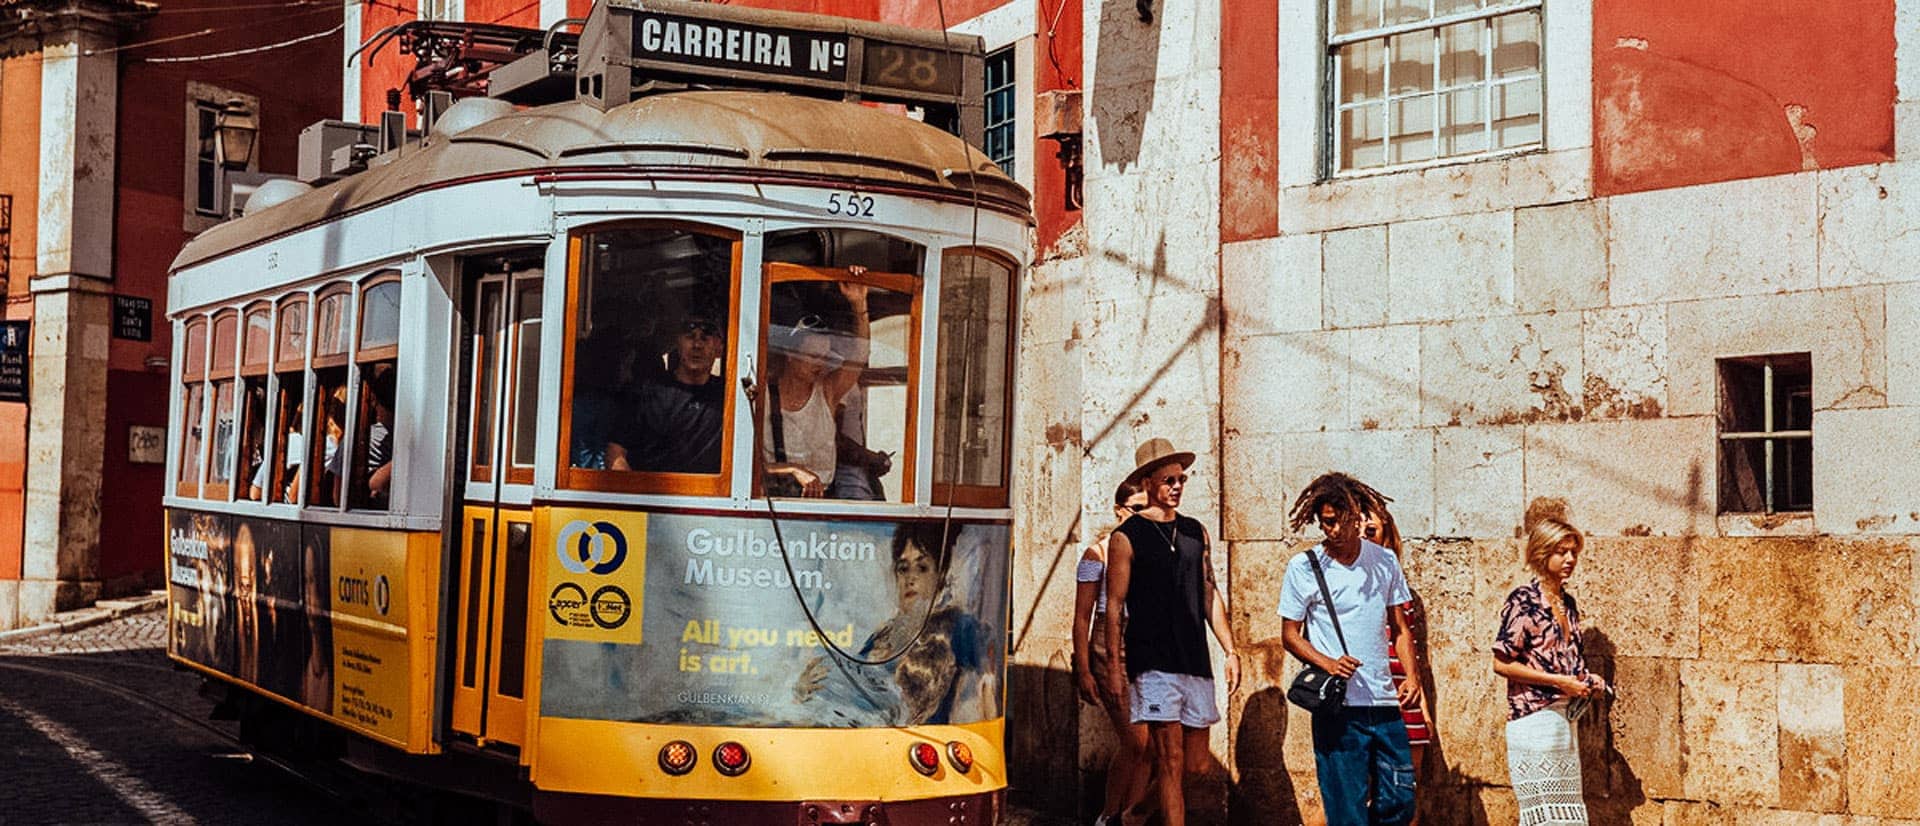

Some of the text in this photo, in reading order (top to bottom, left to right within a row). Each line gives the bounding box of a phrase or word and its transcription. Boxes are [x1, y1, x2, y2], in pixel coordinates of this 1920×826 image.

[641, 18, 938, 87] CARREIRA Nº 28
[827, 193, 875, 217] 552
[686, 527, 876, 562] Gulbenkian
[338, 567, 369, 606] carris
[684, 558, 833, 590] Museum.
[682, 619, 854, 649] All you need
[679, 649, 759, 676] is art.
